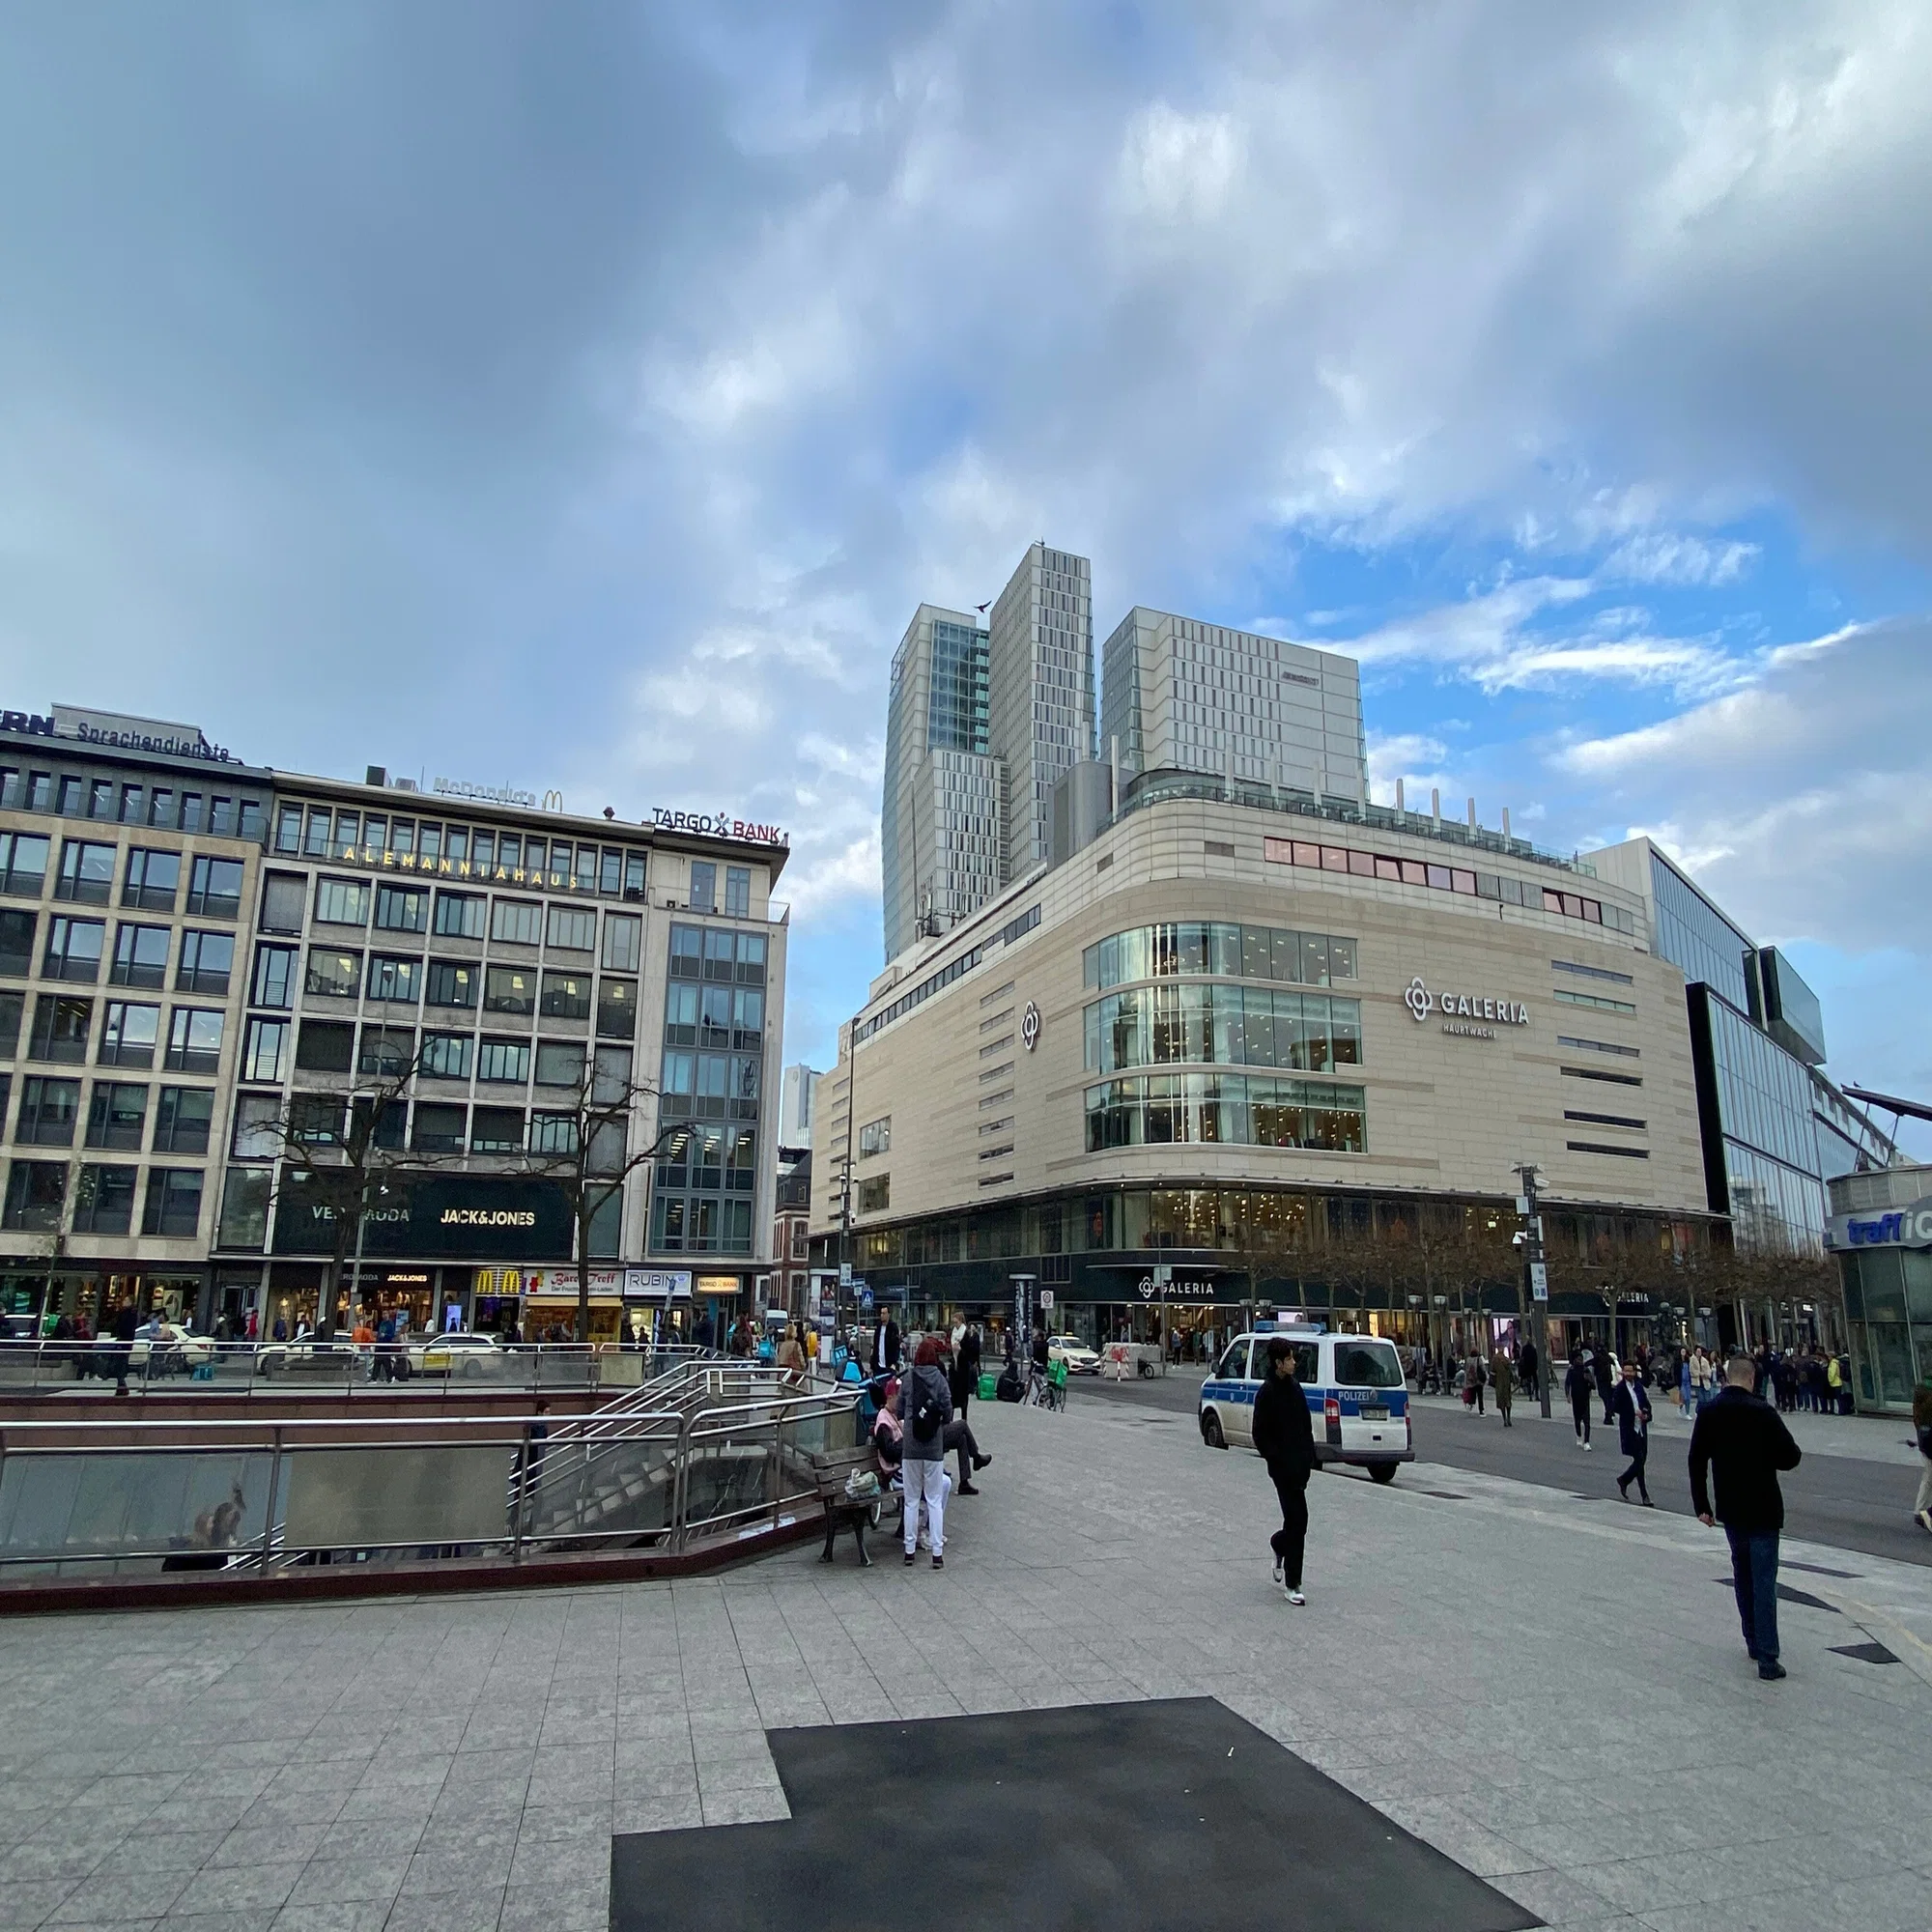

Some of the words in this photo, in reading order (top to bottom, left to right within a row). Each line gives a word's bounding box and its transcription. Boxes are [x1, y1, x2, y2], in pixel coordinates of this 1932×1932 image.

[0, 709, 55, 736] RN
[77, 723, 229, 761] Sprachendienste
[433, 777, 536, 806] McDonald's
[652, 807, 712, 833] TARGO
[732, 821, 780, 843] BANK
[1440, 993, 1529, 1024] GALERIA
[1443, 1023, 1497, 1038] HAUPTWACHE
[440, 1208, 535, 1226] JACK&JONES
[629, 1274, 674, 1287] RUBIN
[1338, 1391, 1369, 1401] POLIZEI
